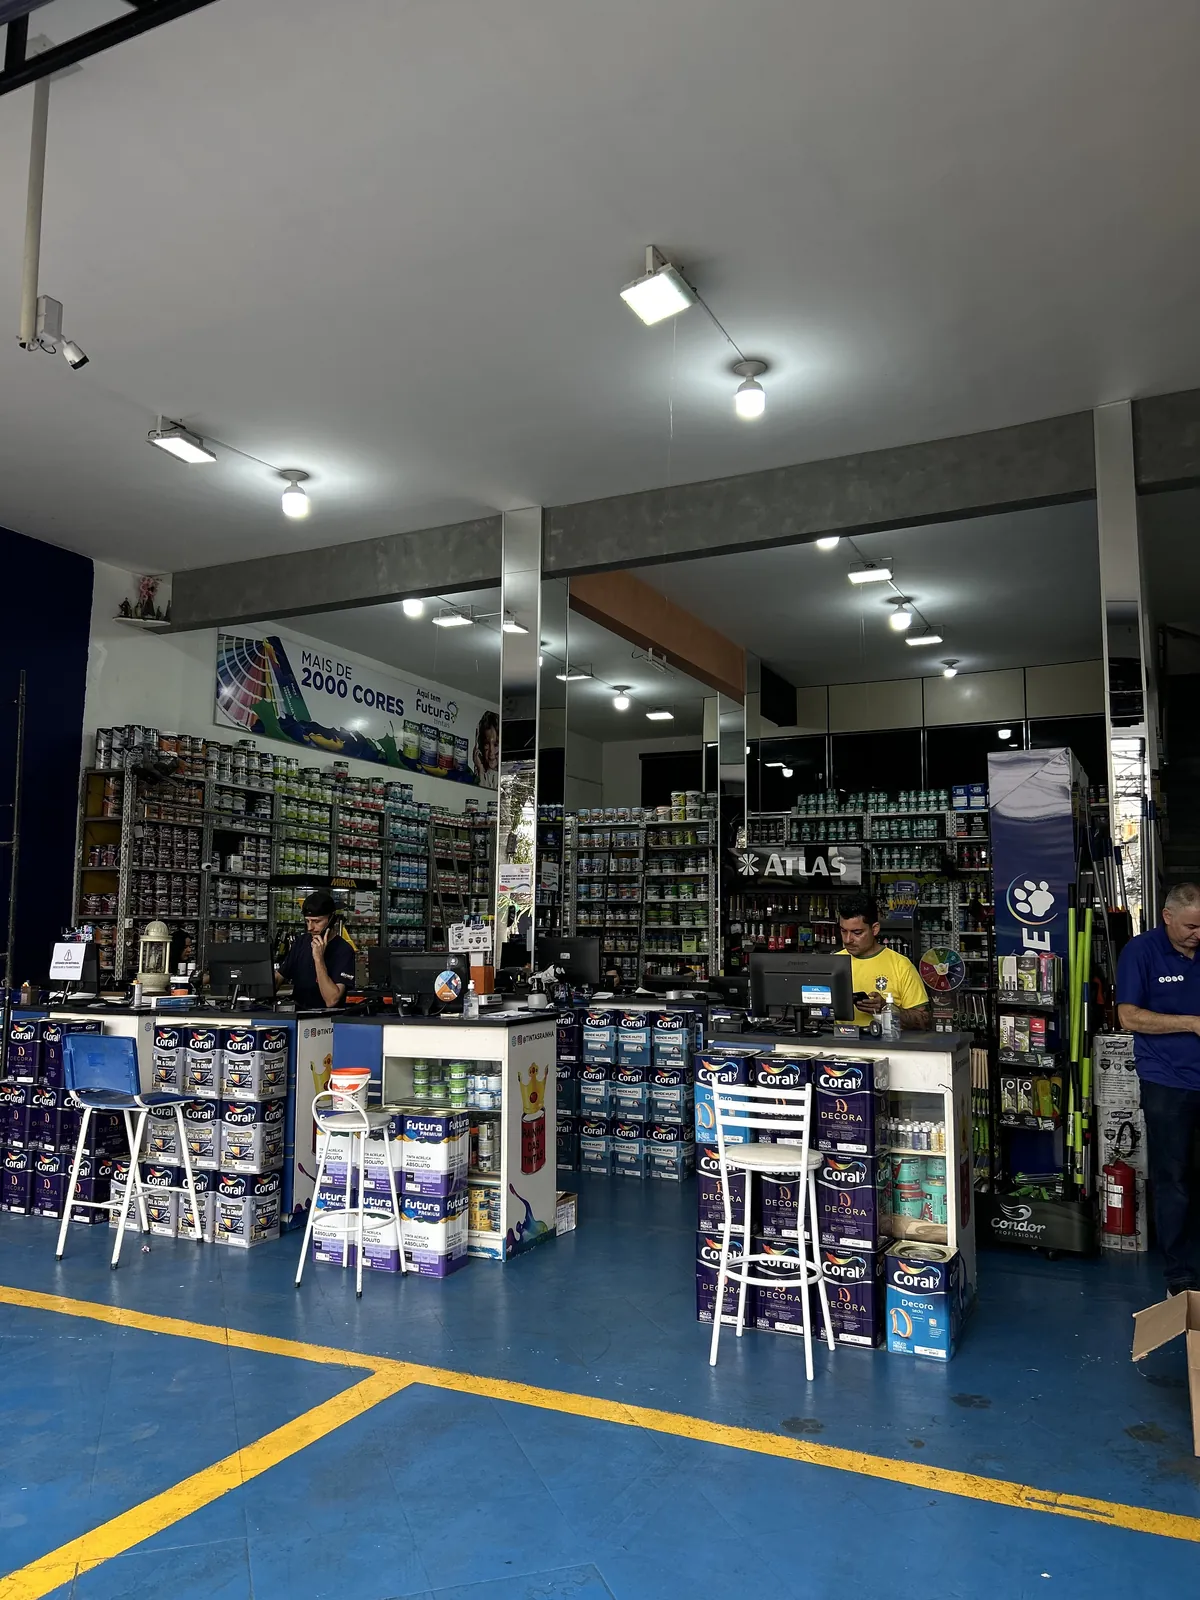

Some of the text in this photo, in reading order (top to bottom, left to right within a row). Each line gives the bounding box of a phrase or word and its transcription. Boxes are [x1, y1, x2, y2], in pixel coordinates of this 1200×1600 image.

[302, 651, 352, 680] MAIS DE
[301, 668, 404, 716] 2000 CORES
[431, 693, 441, 703] tem
[433, 718, 450, 729] tintas
[764, 853, 846, 876] ATLAS
[330, 877, 358, 888] MIRKA
[586, 1017, 606, 1026] Coral
[621, 1019, 643, 1027] Coral
[657, 1020, 679, 1028] Coral
[11, 1030, 31, 1040] Coral
[46, 1032, 59, 1042] Coral
[523, 1031, 554, 1043] @TINTASRAINHA
[156, 1037, 175, 1047] Coral
[189, 1039, 211, 1049] Coral
[226, 1040, 250, 1050] Coral
[263, 1039, 283, 1050] Coral
[583, 1071, 602, 1080] Coral
[618, 1073, 639, 1082] Coral
[655, 1075, 677, 1084] Coral
[758, 1071, 794, 1085] Coral
[819, 1074, 856, 1089] Coral
[11, 1094, 23, 1104] Coral
[41, 1096, 54, 1107] Coral
[186, 1109, 211, 1119] Coral
[225, 1112, 251, 1123] Coral
[264, 1109, 283, 1121] Coral
[821, 1112, 863, 1122] DECORA
[407, 1120, 443, 1131] Futura
[583, 1126, 603, 1135] Coral
[522, 1124, 544, 1139] RAINHA
[616, 1128, 636, 1137] Coral
[653, 1131, 673, 1140] Coral
[528, 1140, 539, 1152] DAS
[524, 1149, 543, 1164] TINTAS
[5, 1159, 23, 1169] Coral
[37, 1162, 56, 1172] Coral
[68, 1165, 88, 1176] Cral
[823, 1166, 860, 1183] Coral
[147, 1175, 168, 1186] Coral
[182, 1178, 204, 1191] Cral
[219, 1183, 241, 1195] Coral
[254, 1181, 276, 1195] Coral
[363, 1197, 391, 1207] utura
[405, 1199, 440, 1212] Futura
[765, 1198, 799, 1208] DECOR
[825, 1204, 867, 1216] DECORA
[990, 1217, 1046, 1233] Condor
[994, 1230, 1042, 1240] PROFISSIONAL
[822, 1261, 860, 1278] Coral
[893, 1271, 934, 1289] Coral
[759, 1290, 801, 1302] DECORA
[901, 1299, 934, 1311] Decora
